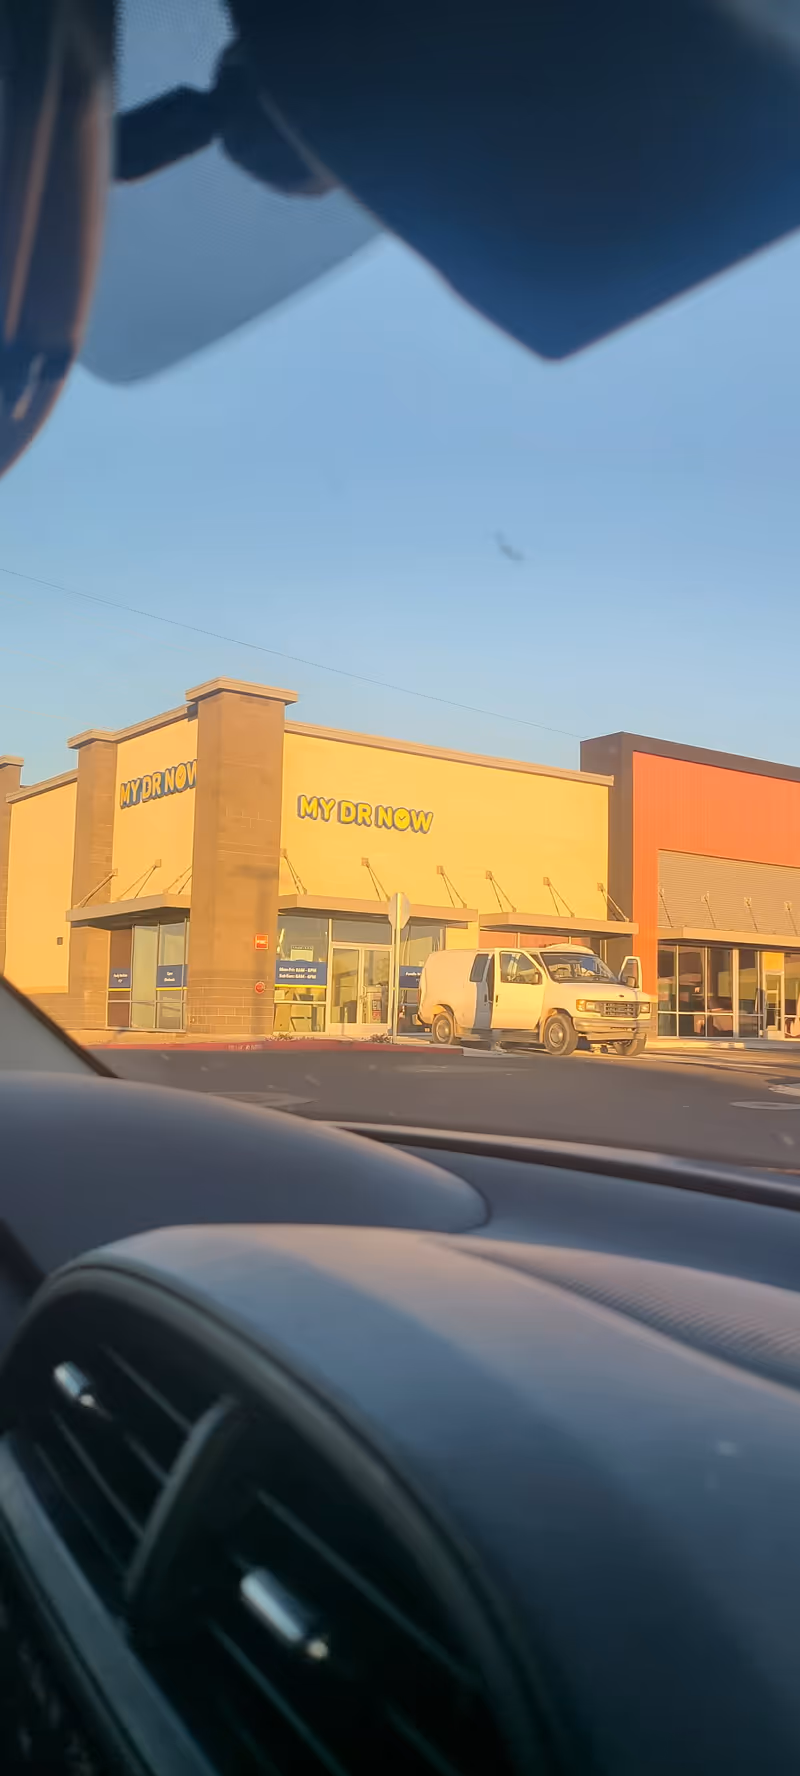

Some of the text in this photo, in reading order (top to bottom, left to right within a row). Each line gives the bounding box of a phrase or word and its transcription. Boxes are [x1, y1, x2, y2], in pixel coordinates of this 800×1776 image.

[120, 777, 141, 809] MY
[142, 771, 164, 803] DR
[297, 794, 434, 834] MY DR NOW
